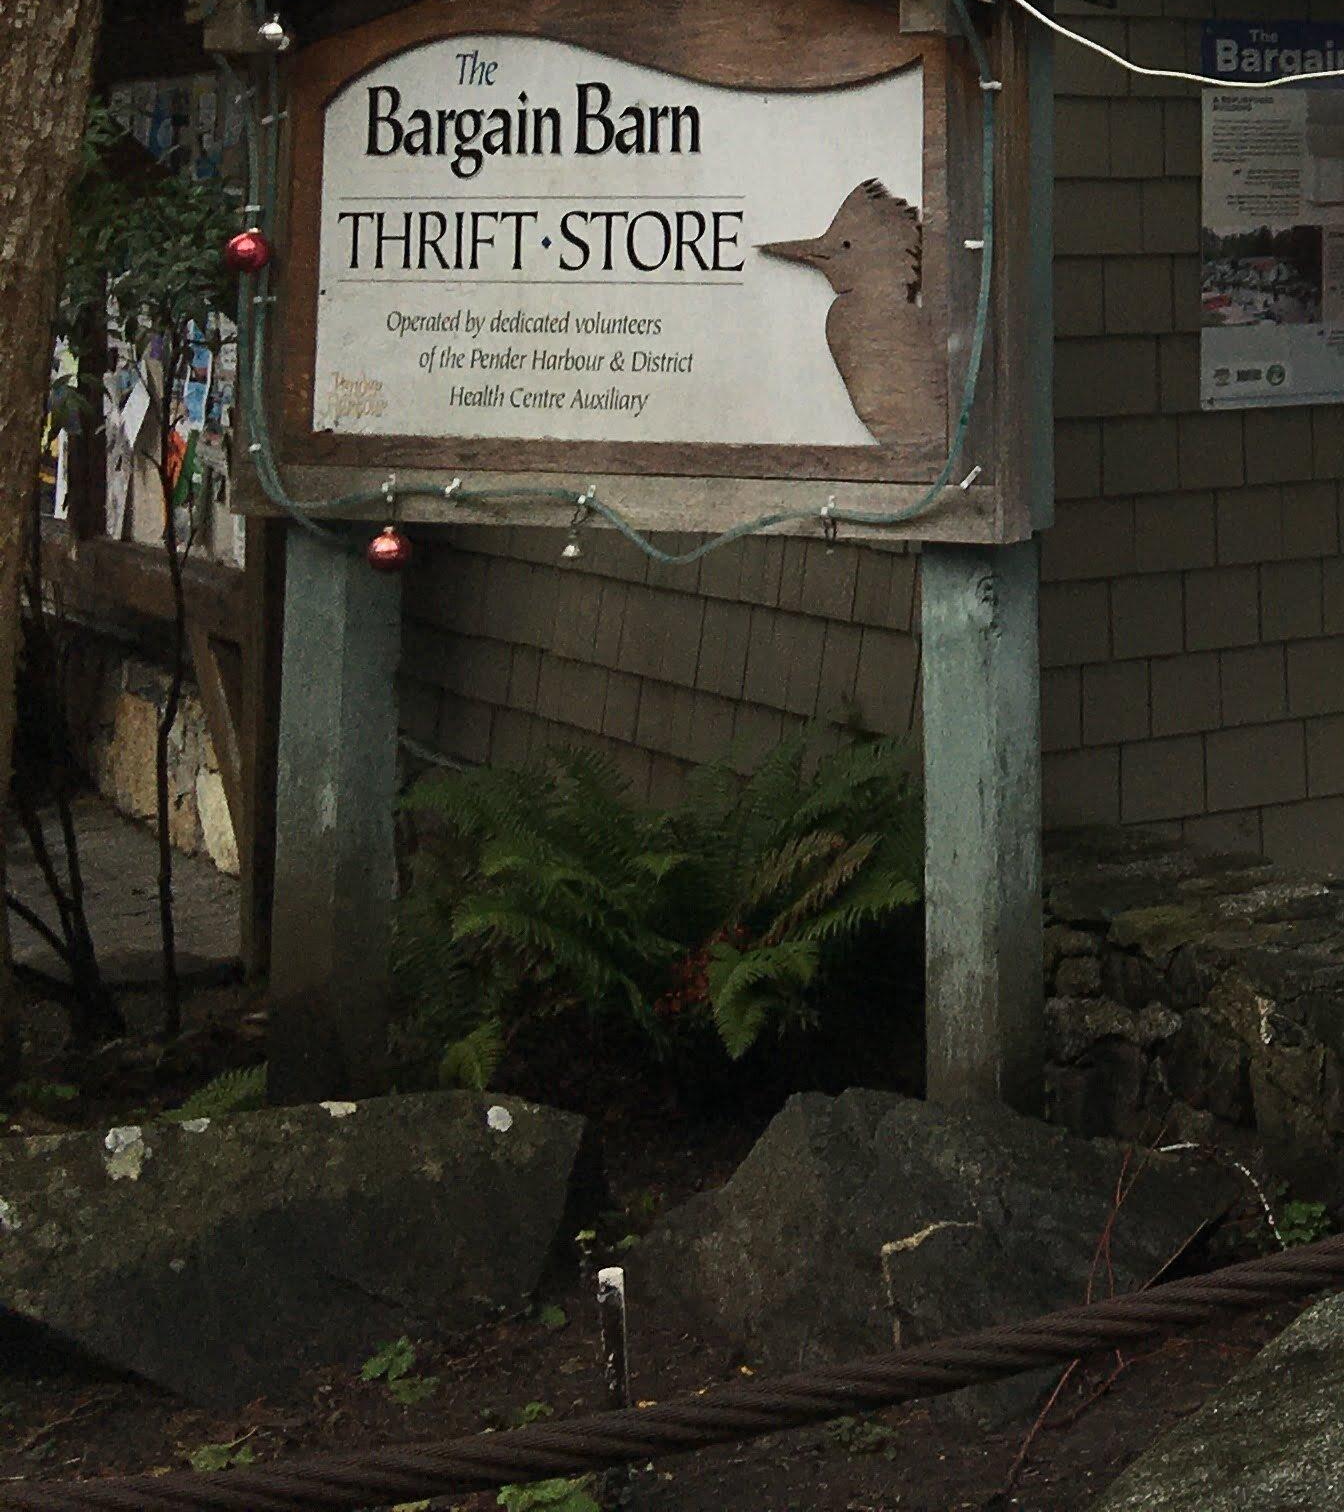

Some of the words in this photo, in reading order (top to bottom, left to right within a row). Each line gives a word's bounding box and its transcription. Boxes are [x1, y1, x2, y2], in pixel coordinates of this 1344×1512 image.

[1249, 29, 1279, 43] The
[455, 49, 499, 86] The
[366, 85, 561, 179] Bargain
[574, 81, 701, 155] Barn
[338, 210, 538, 271] THRIFT
[558, 209, 746, 272] STORE
[386, 309, 461, 337] Operated
[464, 310, 486, 338] by
[489, 309, 571, 335] dedicated
[574, 311, 663, 336] volunteers
[418, 345, 439, 373] of
[439, 345, 466, 369] the
[470, 347, 528, 370] Pender
[530, 347, 606, 372] Harbour
[608, 350, 626, 372] &
[631, 349, 695, 374] District
[449, 384, 506, 408] Health
[509, 386, 566, 409] Centre
[570, 386, 651, 418] Auxiliary
